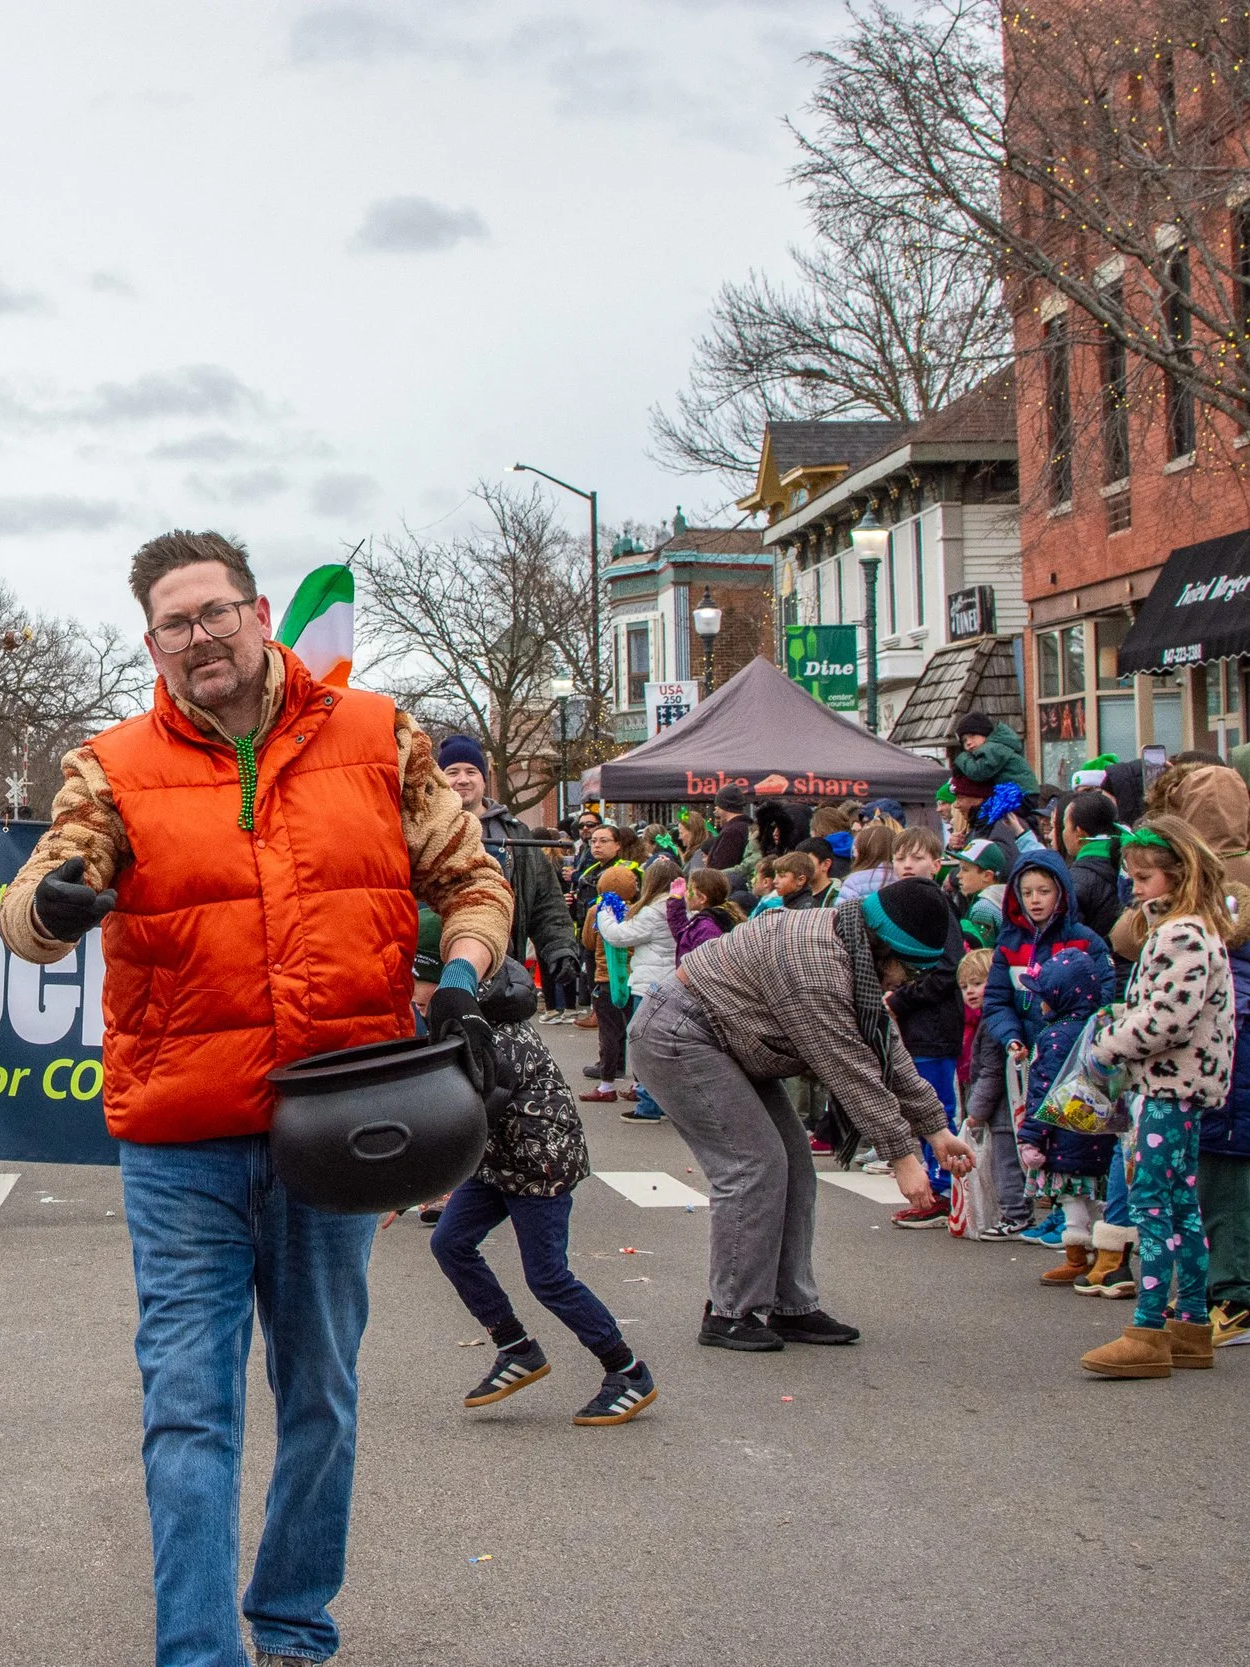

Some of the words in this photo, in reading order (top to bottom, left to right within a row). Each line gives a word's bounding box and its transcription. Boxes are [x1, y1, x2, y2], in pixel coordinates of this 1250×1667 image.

[804, 660, 855, 676] Dine
[659, 684, 684, 696] USA
[663, 696, 682, 704] 250
[793, 772, 869, 797] share
